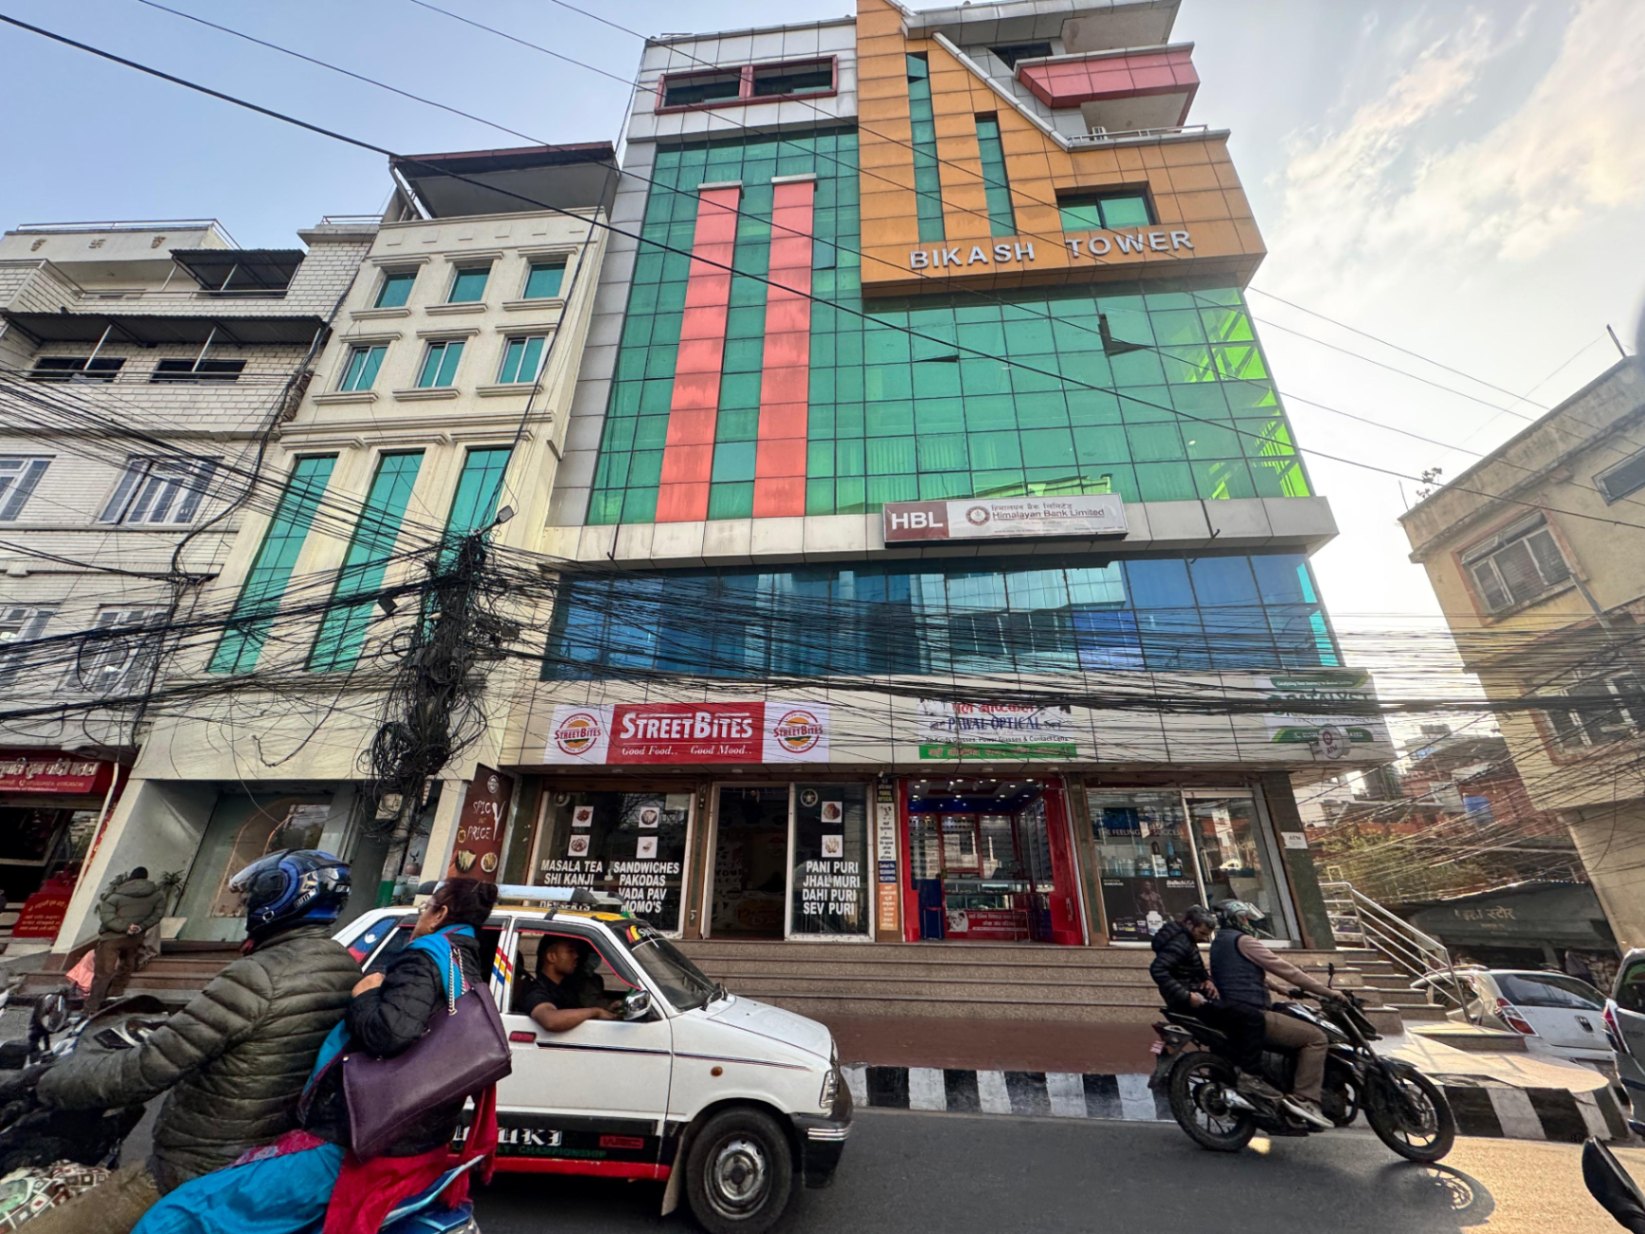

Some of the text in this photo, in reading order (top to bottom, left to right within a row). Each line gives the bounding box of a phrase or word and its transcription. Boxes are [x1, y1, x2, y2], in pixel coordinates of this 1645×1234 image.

[909, 230, 1195, 270] BIKASH TOWER
[992, 508, 1105, 520] Himalayan Bank Limited
[891, 511, 944, 531] HBL
[991, 716, 1041, 731] OPTICAL
[622, 746, 646, 756] Good
[690, 745, 715, 755] Good
[541, 859, 603, 873] MASALA TEA
[613, 861, 680, 875] SANDWICHES
[806, 860, 859, 874] PANI PURI
[544, 873, 595, 886] SHI KANJI
[619, 874, 666, 886] PAKODAS
[802, 875, 861, 888] JHAL MURI
[618, 887, 667, 900] VADA PAV
[802, 889, 857, 902] DAHI PURI
[620, 900, 662, 914] MOMO'S
[803, 902, 855, 916] SEV PURI
